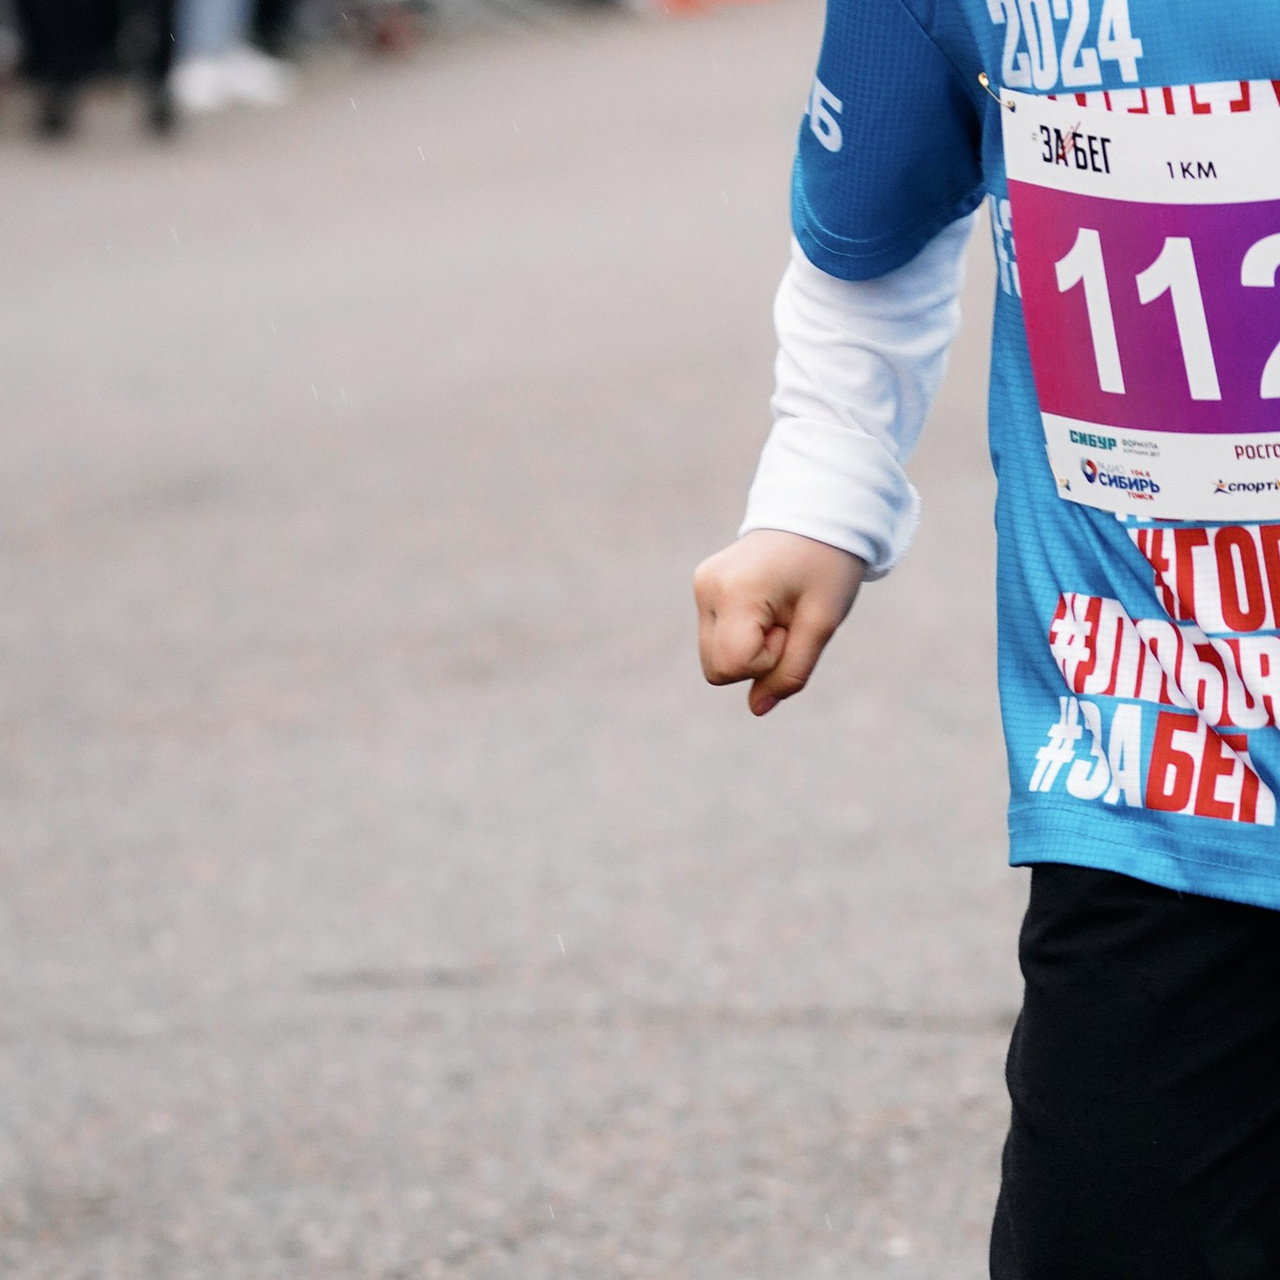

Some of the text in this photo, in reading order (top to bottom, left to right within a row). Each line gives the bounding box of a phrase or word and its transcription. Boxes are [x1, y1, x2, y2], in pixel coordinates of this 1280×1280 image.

[1167, 161, 1174, 178] 1
[1069, 429, 1117, 451] СИБУР
[1098, 472, 1161, 494] СИБИРЬ
